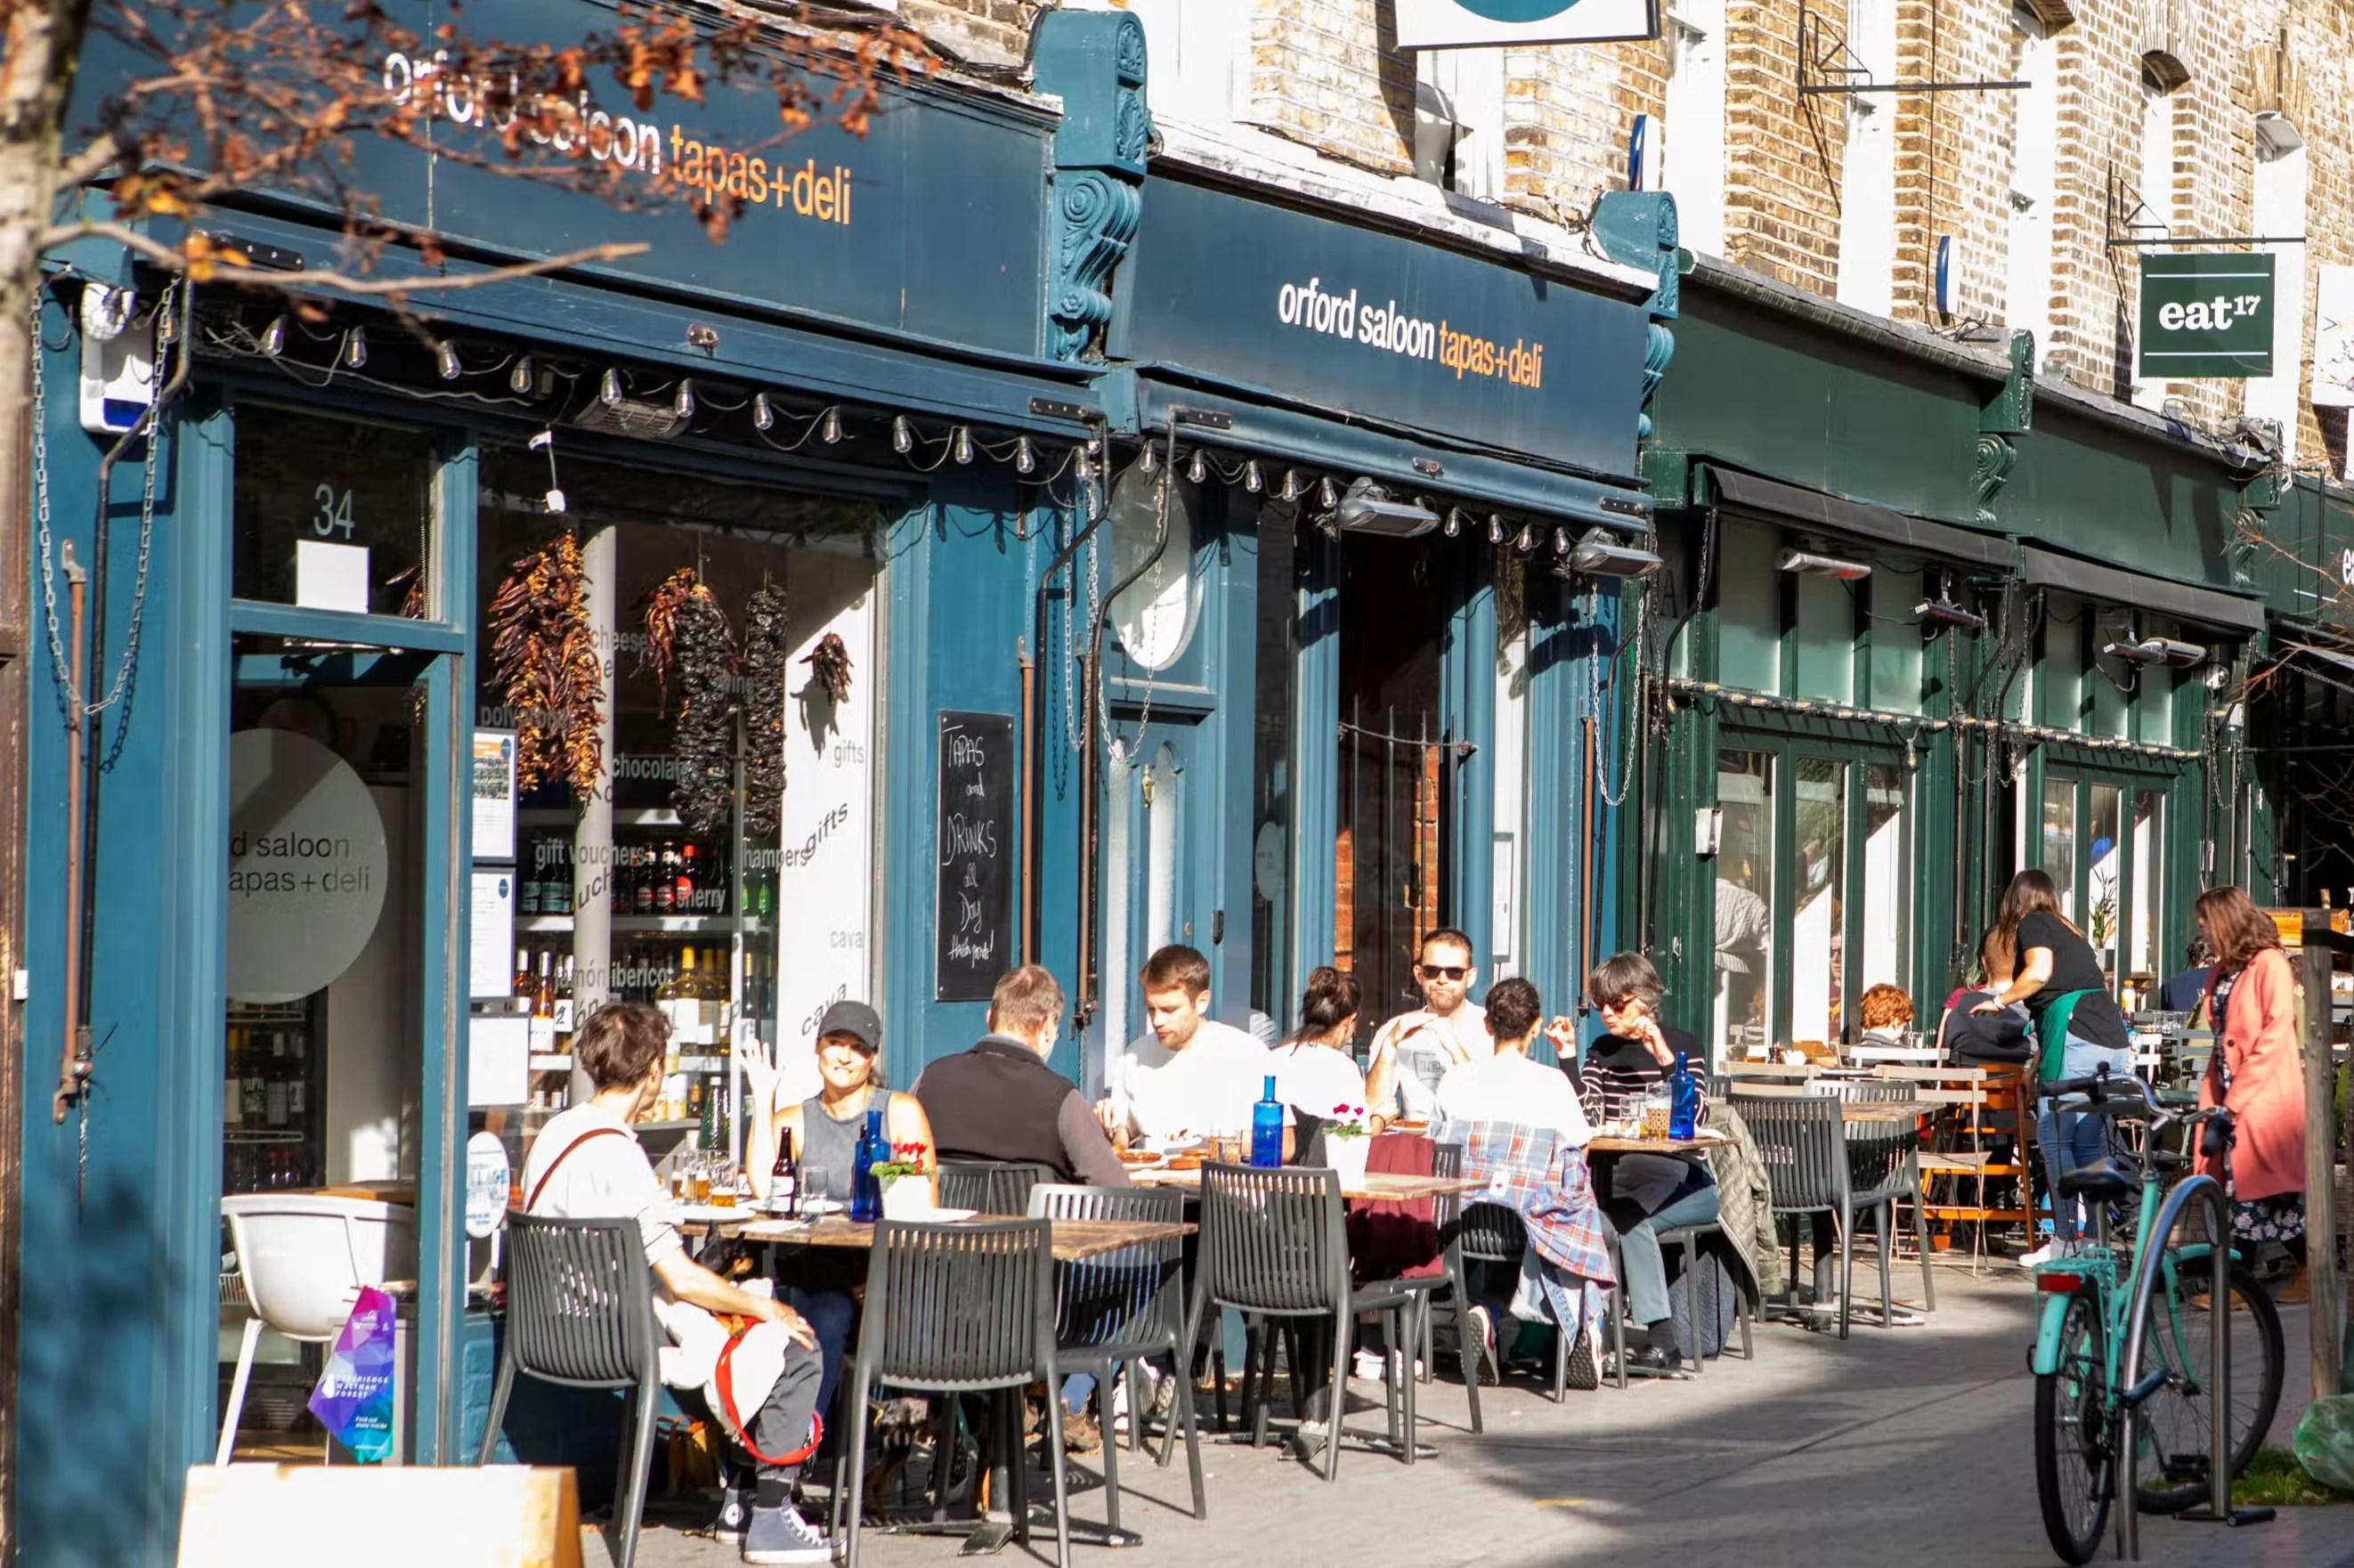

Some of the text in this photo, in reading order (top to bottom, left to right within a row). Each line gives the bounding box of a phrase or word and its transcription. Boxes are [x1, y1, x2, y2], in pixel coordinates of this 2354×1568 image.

[669, 123, 851, 225] tapas+deli
[1278, 277, 1545, 389] orford saloon tapas+deli
[313, 483, 355, 540] 34
[833, 740, 864, 768] gifts
[943, 724, 985, 768] TAPAS
[612, 752, 693, 783] chocolat
[966, 771, 986, 798] and
[256, 831, 350, 858] saloon
[535, 838, 645, 871] gift vouchers
[942, 812, 997, 866] DRINKS
[743, 840, 808, 874] hampers
[963, 862, 978, 889] all
[676, 884, 726, 914] sherry
[830, 930, 863, 949] cava
